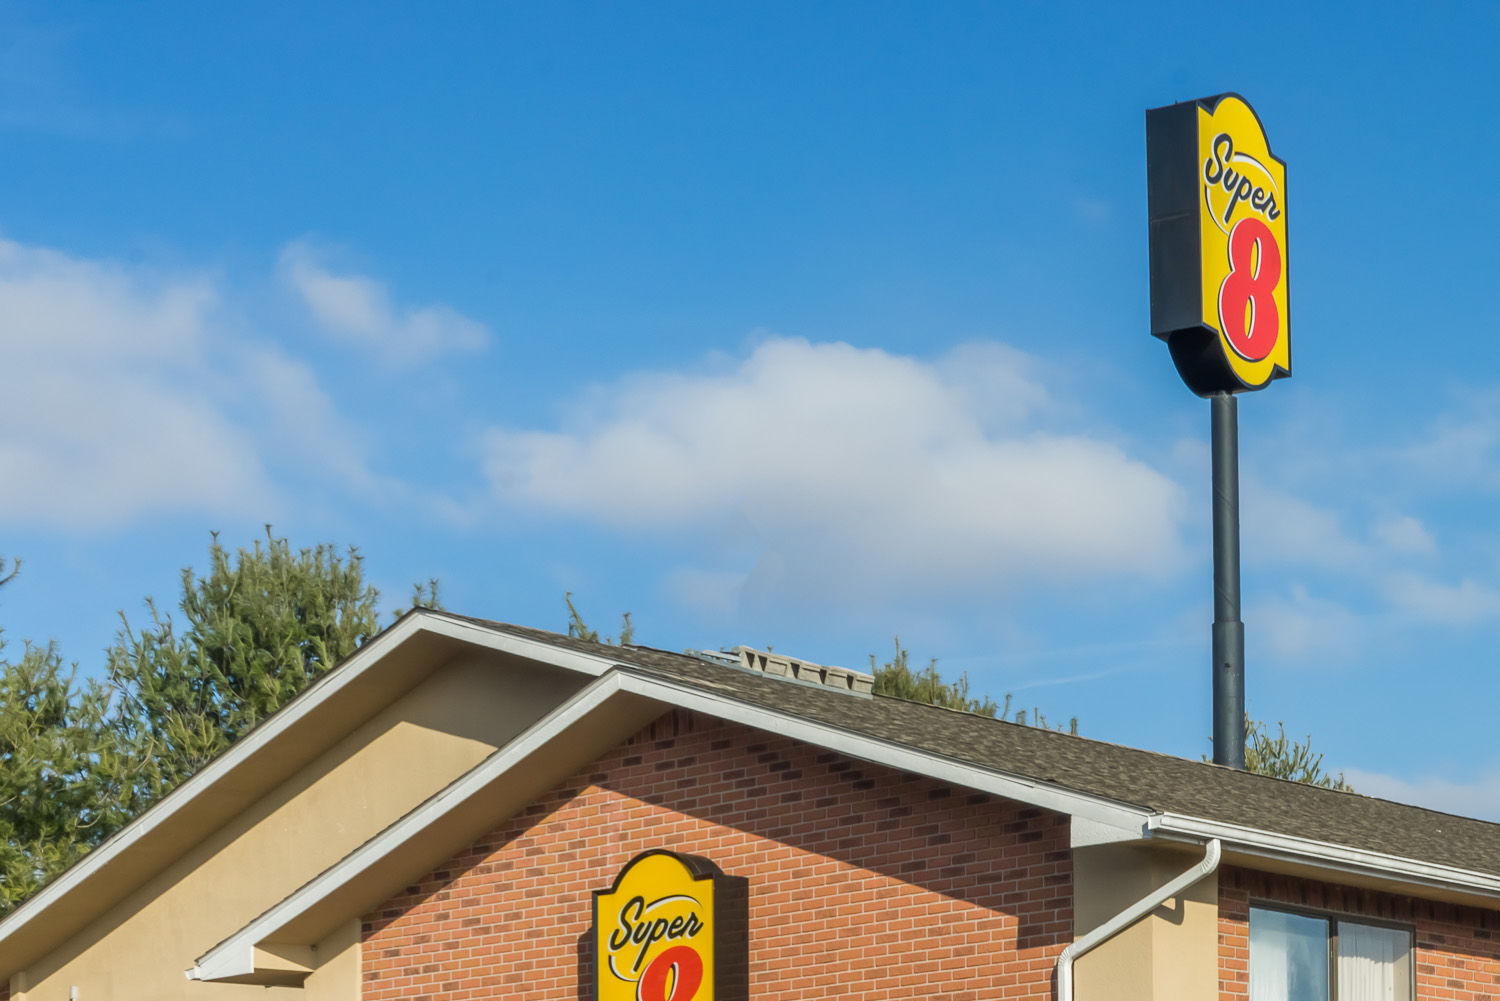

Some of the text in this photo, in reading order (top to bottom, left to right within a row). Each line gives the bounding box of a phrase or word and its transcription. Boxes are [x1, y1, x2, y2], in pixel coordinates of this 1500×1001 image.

[1204, 133, 1280, 225] Super
[1217, 217, 1281, 363] 8
[608, 896, 704, 974] Super
